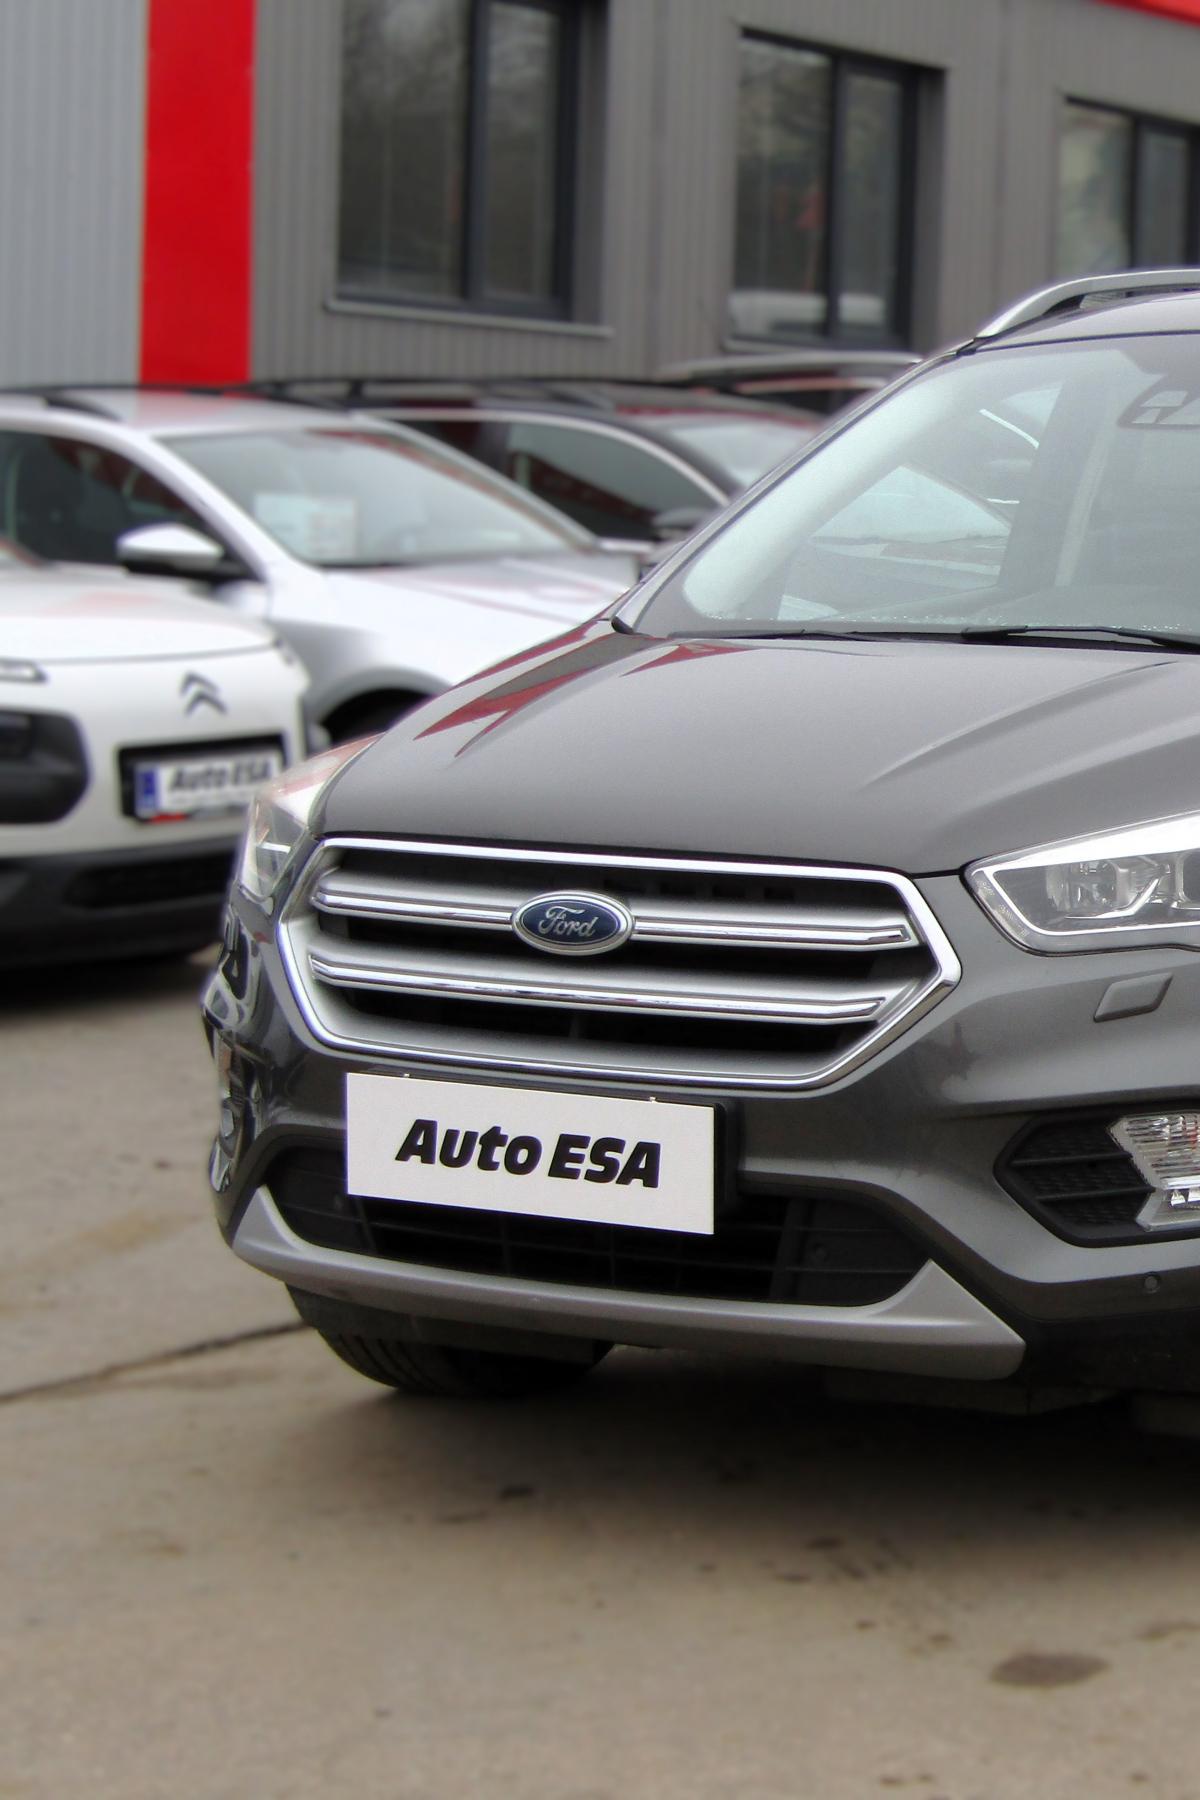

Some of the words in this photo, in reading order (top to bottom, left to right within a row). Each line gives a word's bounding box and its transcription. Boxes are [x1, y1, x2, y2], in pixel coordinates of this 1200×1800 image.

[538, 905, 598, 937] Ford
[395, 1118, 543, 1175] Auto
[547, 1133, 661, 1188] ESA
